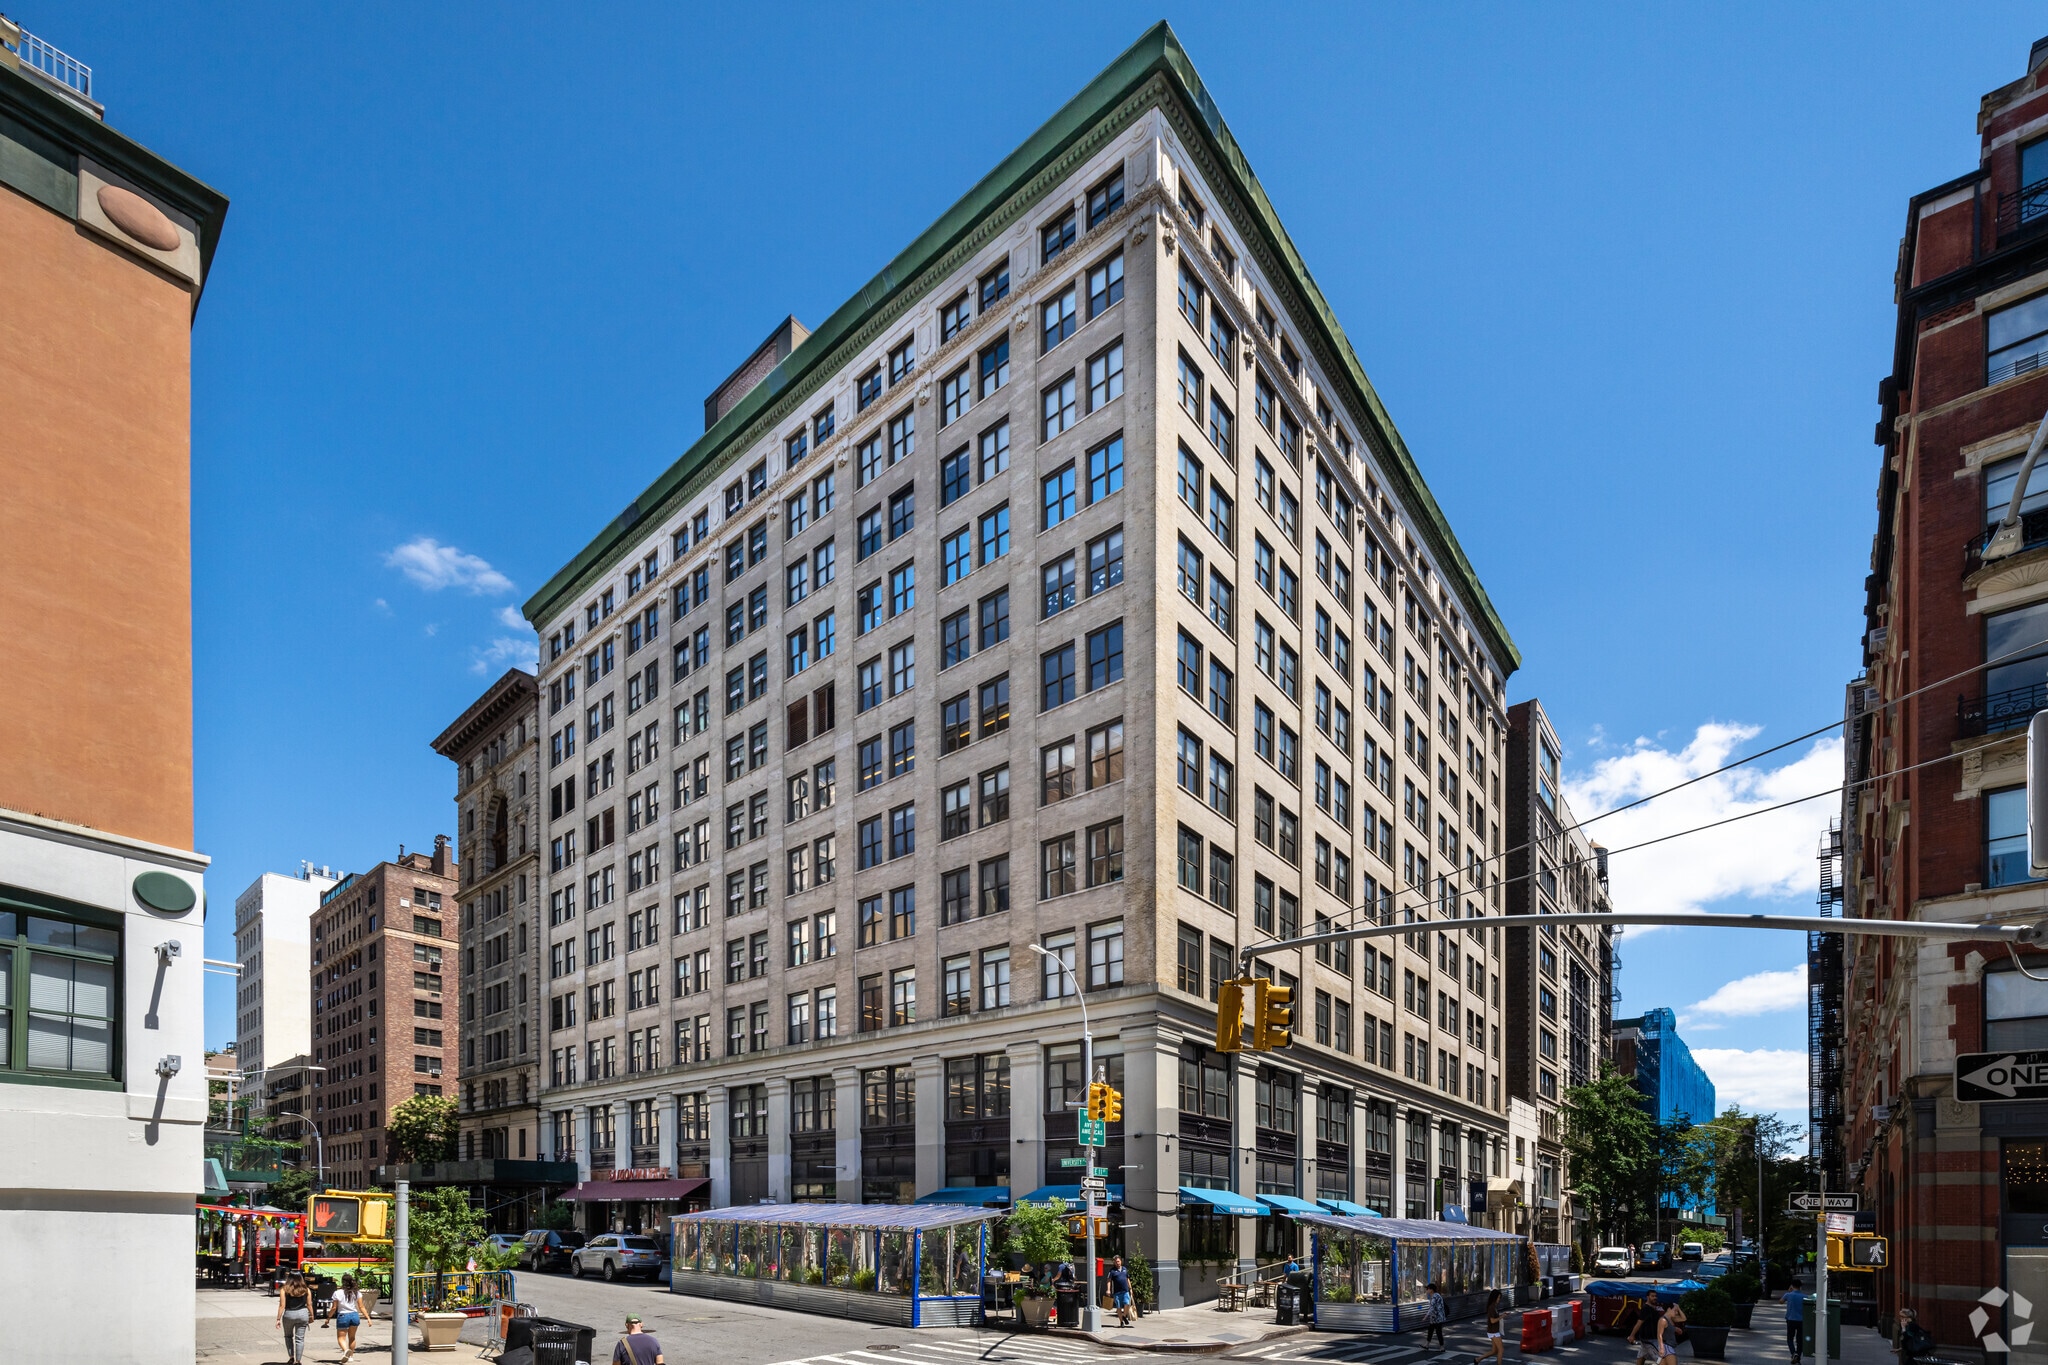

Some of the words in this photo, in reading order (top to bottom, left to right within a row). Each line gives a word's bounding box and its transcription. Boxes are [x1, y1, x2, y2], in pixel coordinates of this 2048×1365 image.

[1986, 1065, 2048, 1086] ONE
[1800, 1198, 1819, 1206] ONE
[1827, 1198, 1848, 1206] WAY
